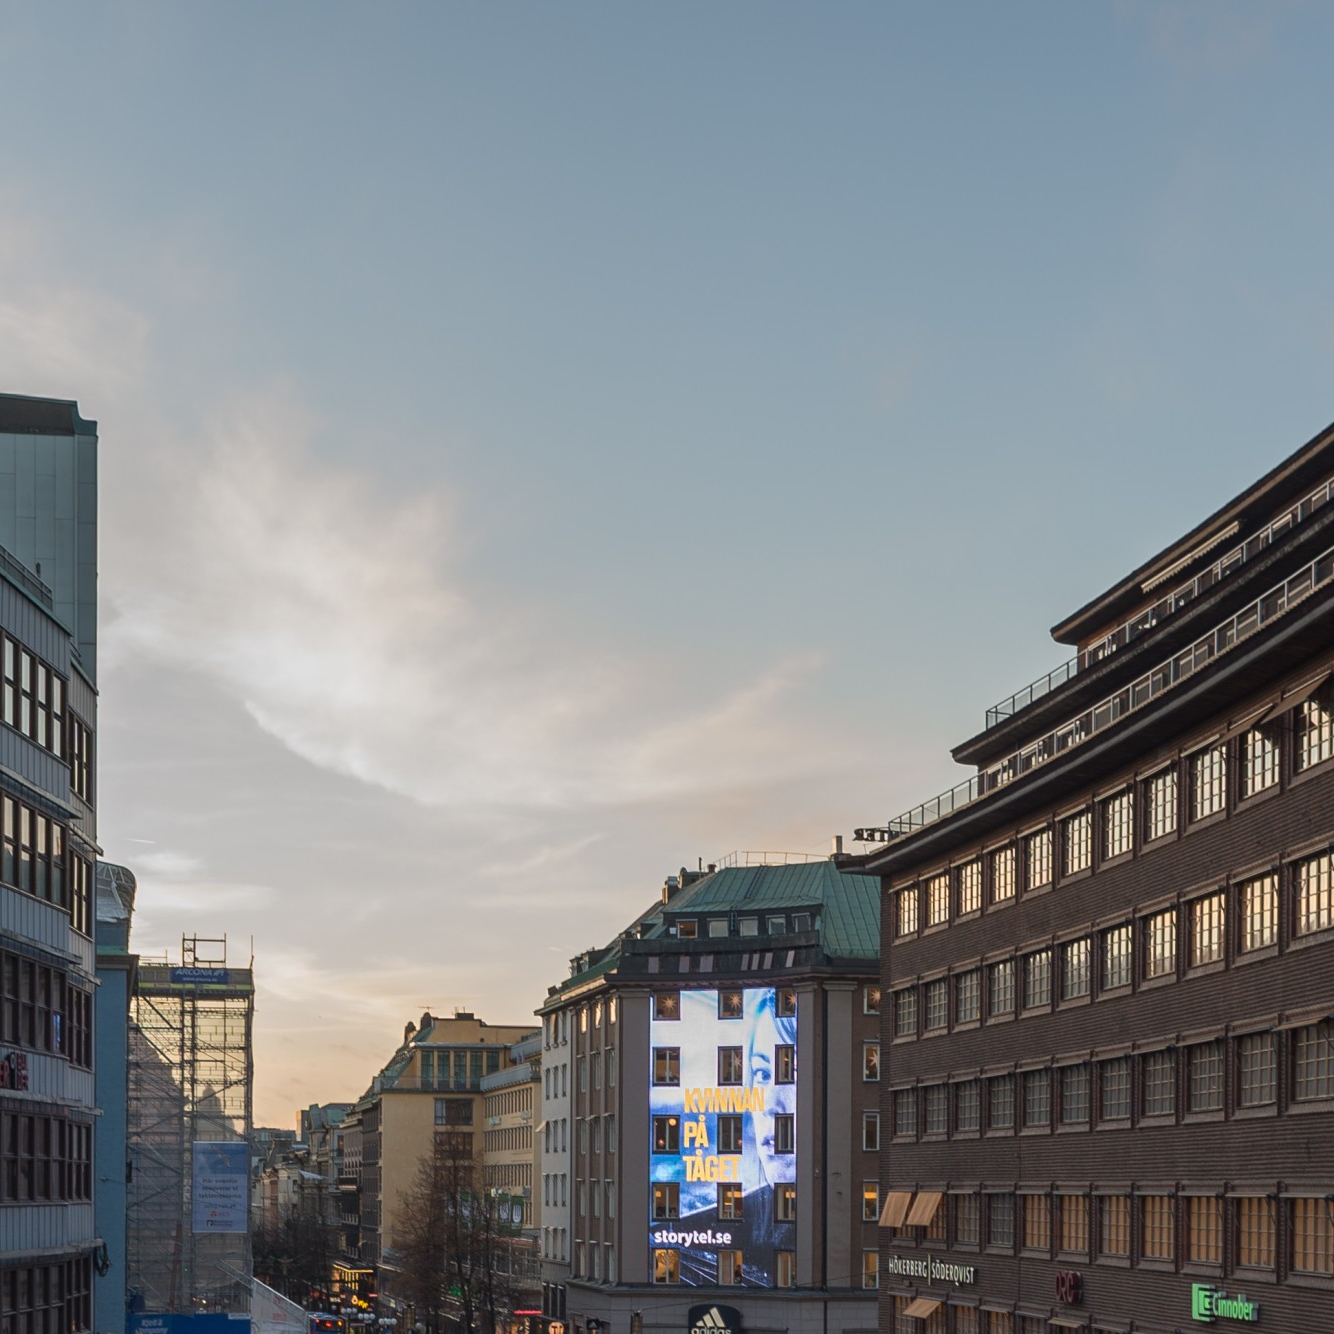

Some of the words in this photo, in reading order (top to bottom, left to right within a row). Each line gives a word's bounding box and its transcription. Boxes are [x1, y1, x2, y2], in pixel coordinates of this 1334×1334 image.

[683, 1087, 765, 1113] KVINNAN
[683, 1115, 709, 1148] PÅ
[683, 1149, 741, 1182] TÅGET
[654, 1230, 732, 1247] storytel.se
[888, 1255, 927, 1278] HÖKERBERG
[931, 1259, 975, 1287] SÖDERQVIST
[1212, 1292, 1255, 1320] Cinnober
